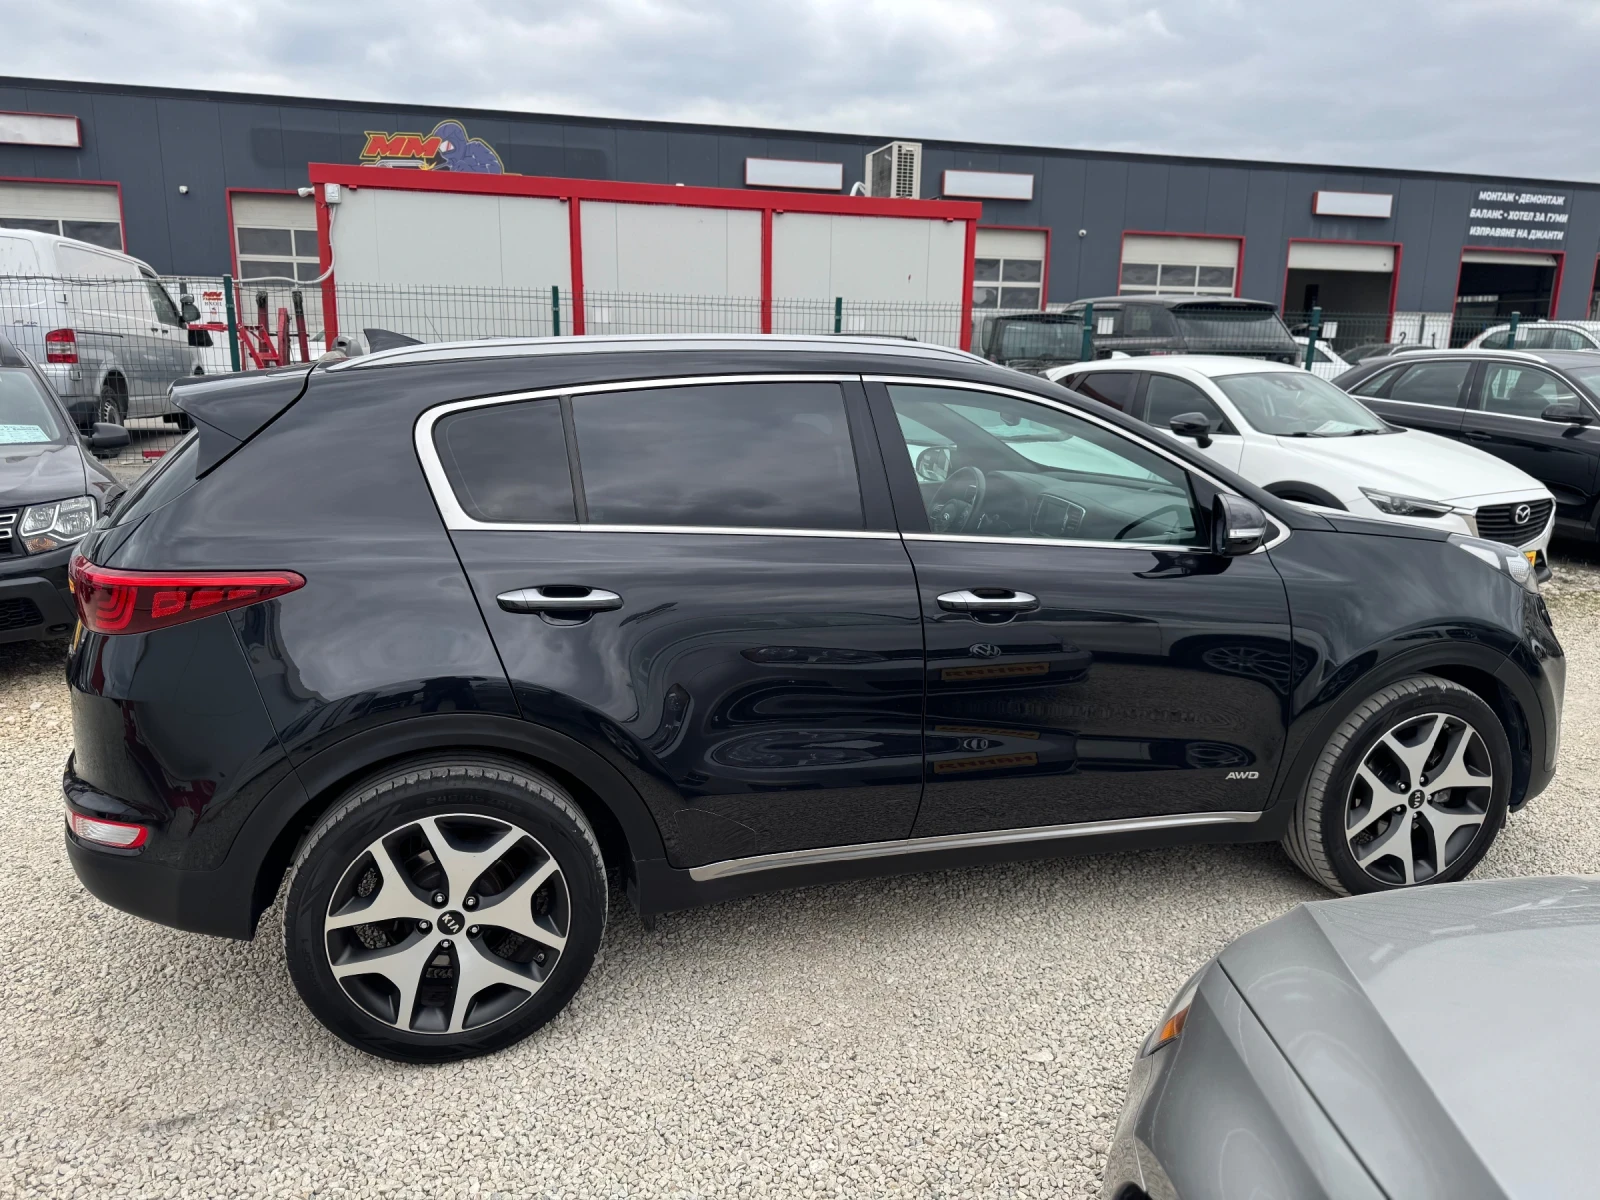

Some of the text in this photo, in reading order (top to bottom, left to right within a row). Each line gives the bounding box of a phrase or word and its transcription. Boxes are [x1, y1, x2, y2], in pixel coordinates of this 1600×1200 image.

[362, 134, 442, 158] MM
[1478, 191, 1565, 206] МОНТАЖ ДЕМОНТАЖ
[1469, 208, 1569, 223] БАЛАНС ХОТЕЛ ЗА ГУМИ
[1469, 226, 1564, 240] ИЗПРАВЯНЕ НА ДЖАНТИ
[1225, 771, 1260, 780] AWD
[1413, 791, 1421, 808] KIA
[441, 913, 460, 933] KIA
